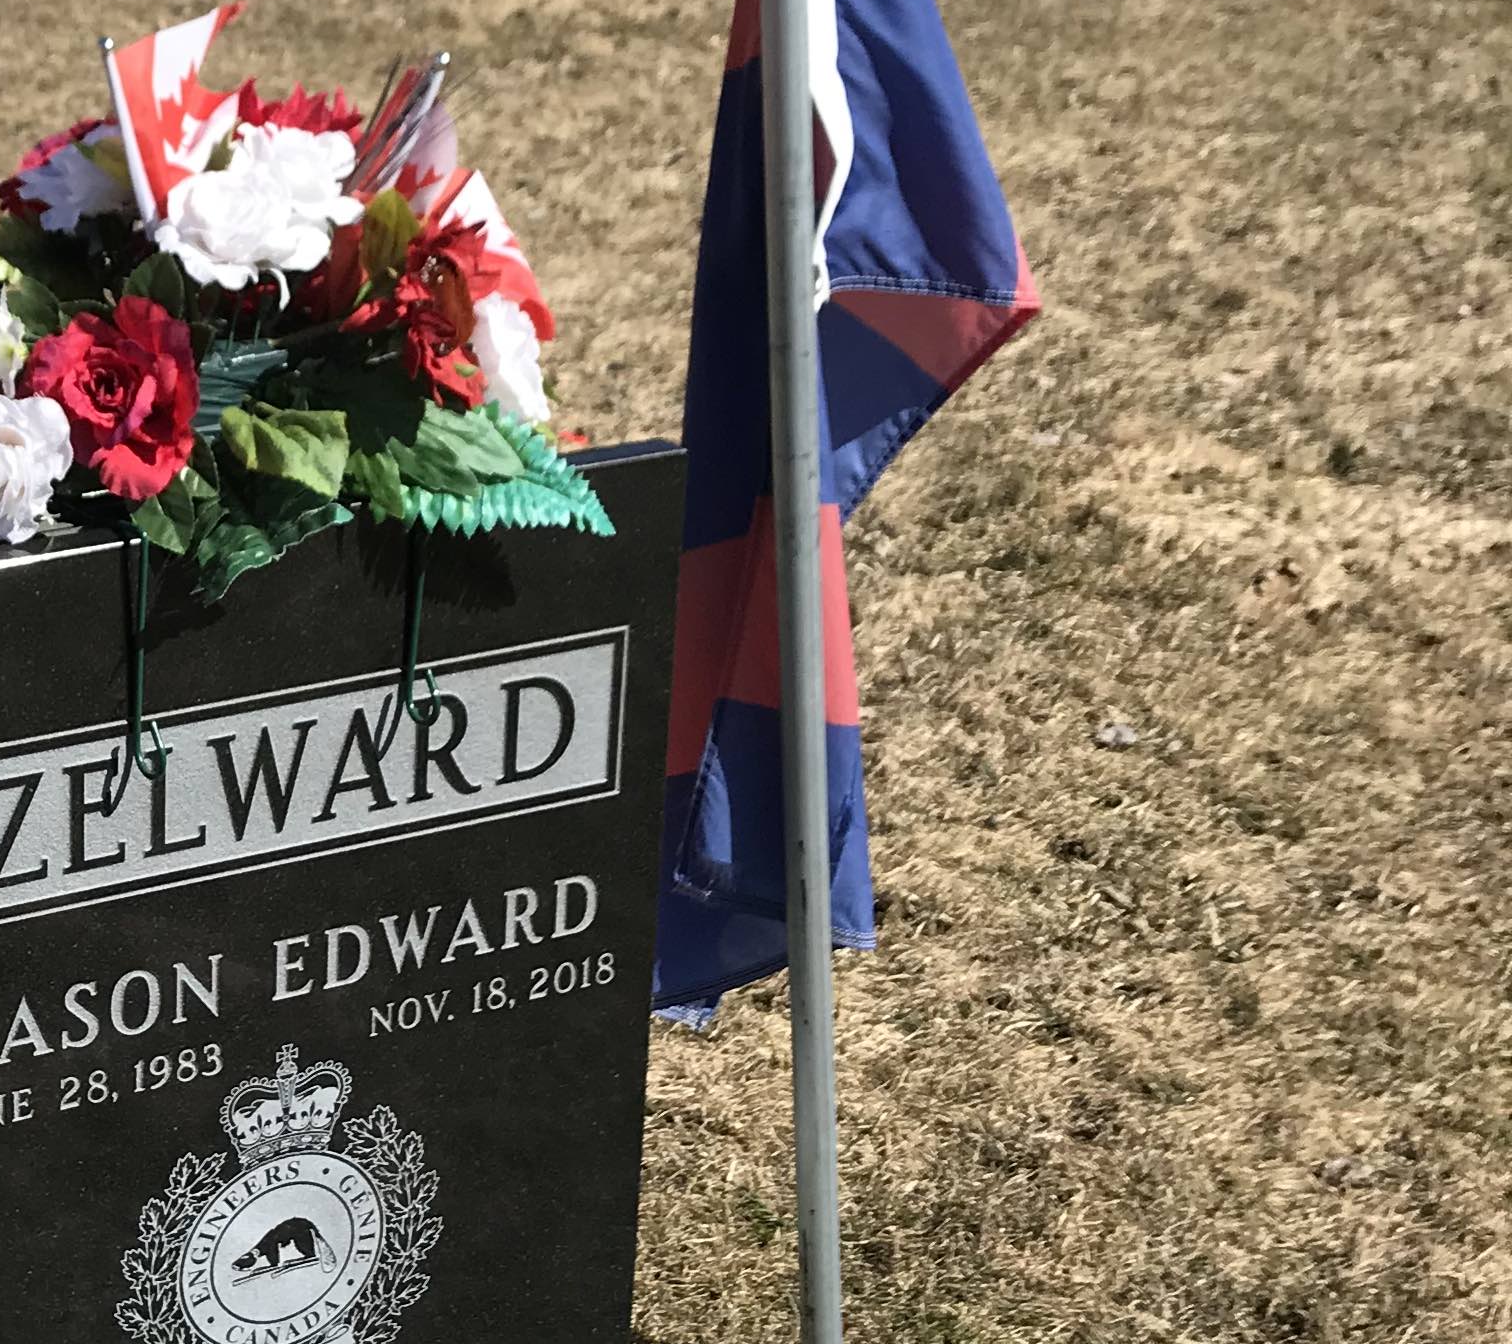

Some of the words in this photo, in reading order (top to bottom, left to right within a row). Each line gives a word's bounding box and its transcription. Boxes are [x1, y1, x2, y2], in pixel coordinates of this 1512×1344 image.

[271, 874, 599, 1002] EDWARD
[368, 989, 456, 1038] NOV.
[471, 976, 517, 1014] 18,
[528, 951, 617, 1001] 2018
[59, 1069, 119, 1112] 28,
[133, 1042, 225, 1093] 1983
[187, 1159, 302, 1307] ENGINEERS
